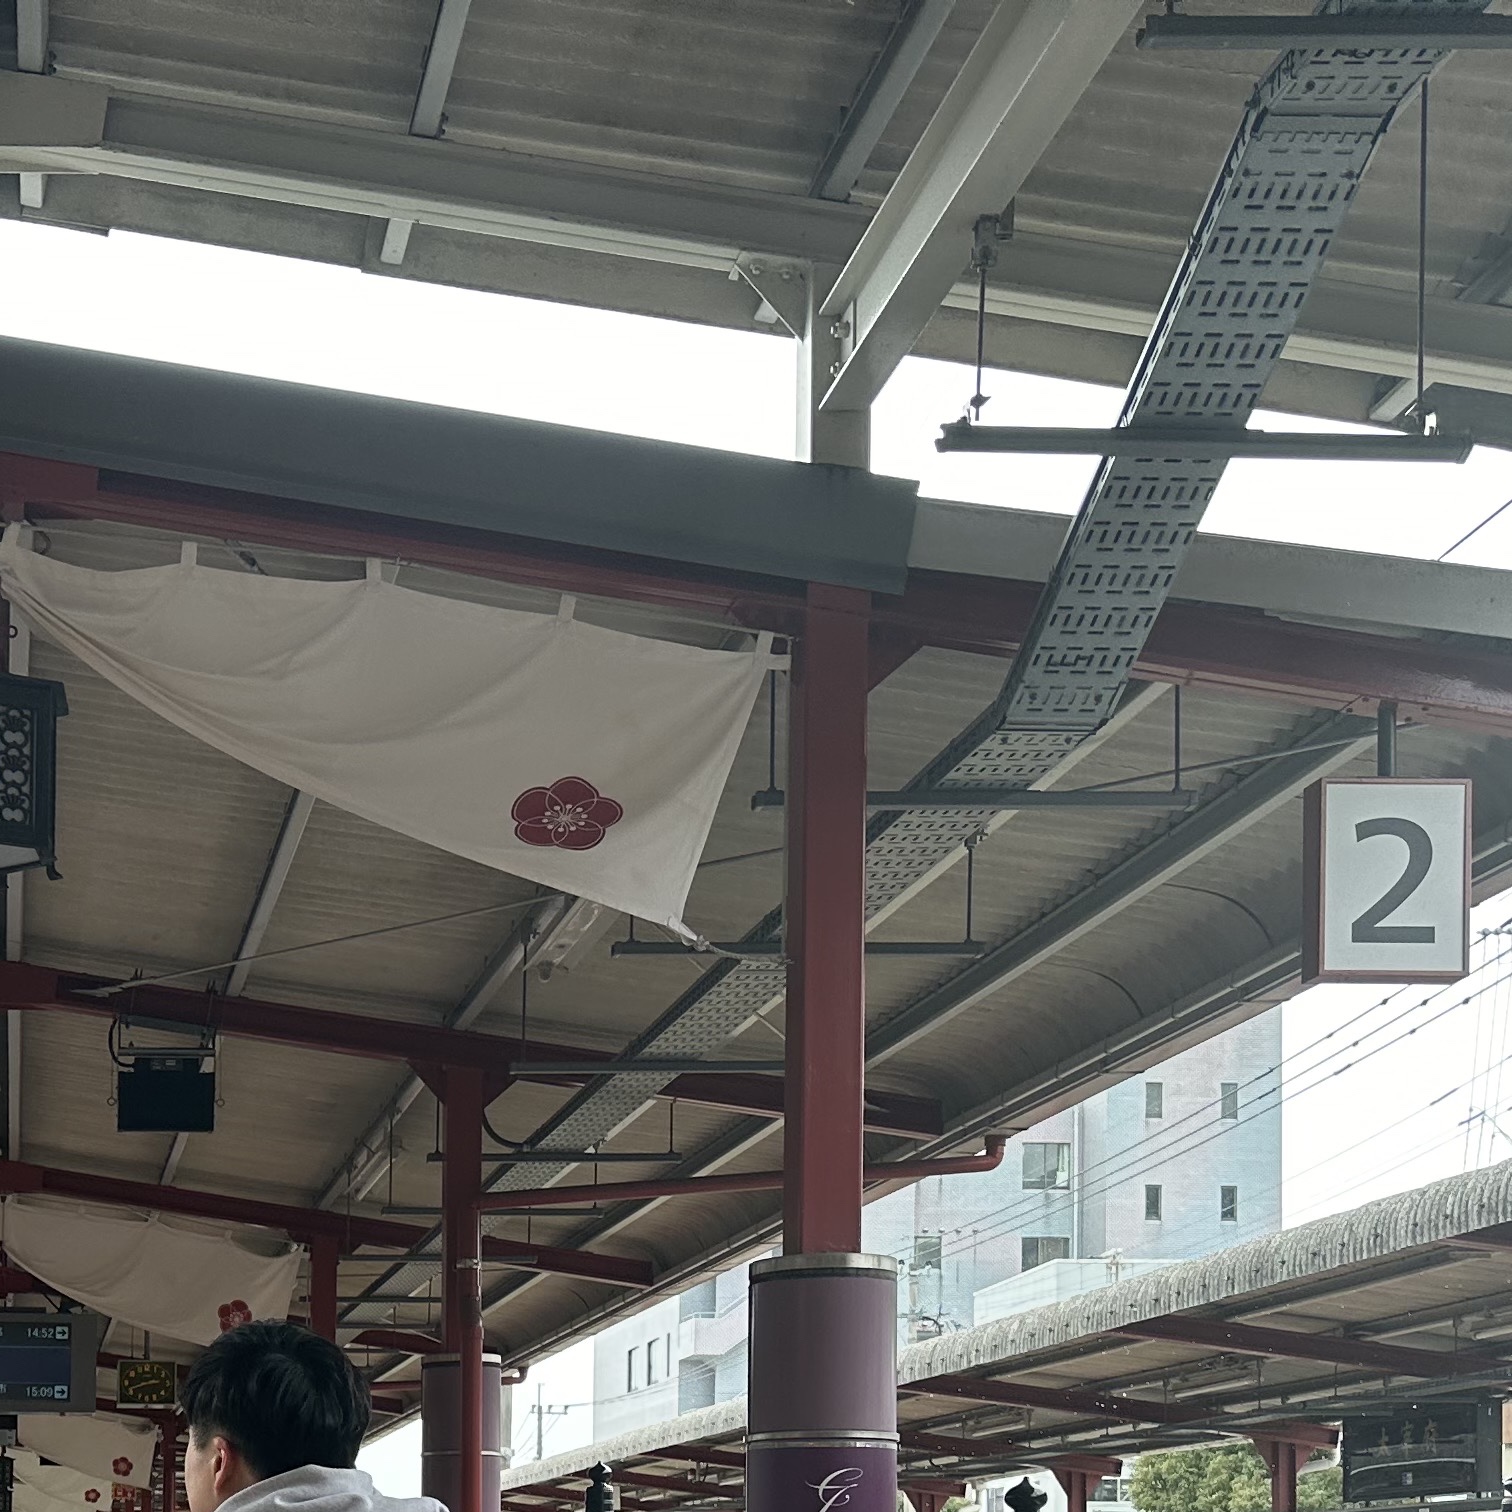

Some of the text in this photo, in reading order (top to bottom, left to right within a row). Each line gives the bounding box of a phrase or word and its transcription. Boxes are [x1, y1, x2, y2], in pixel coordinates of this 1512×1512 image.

[1351, 816, 1436, 944] 2
[26, 1327, 54, 1339] 14:52
[26, 1386, 54, 1398] 15:09
